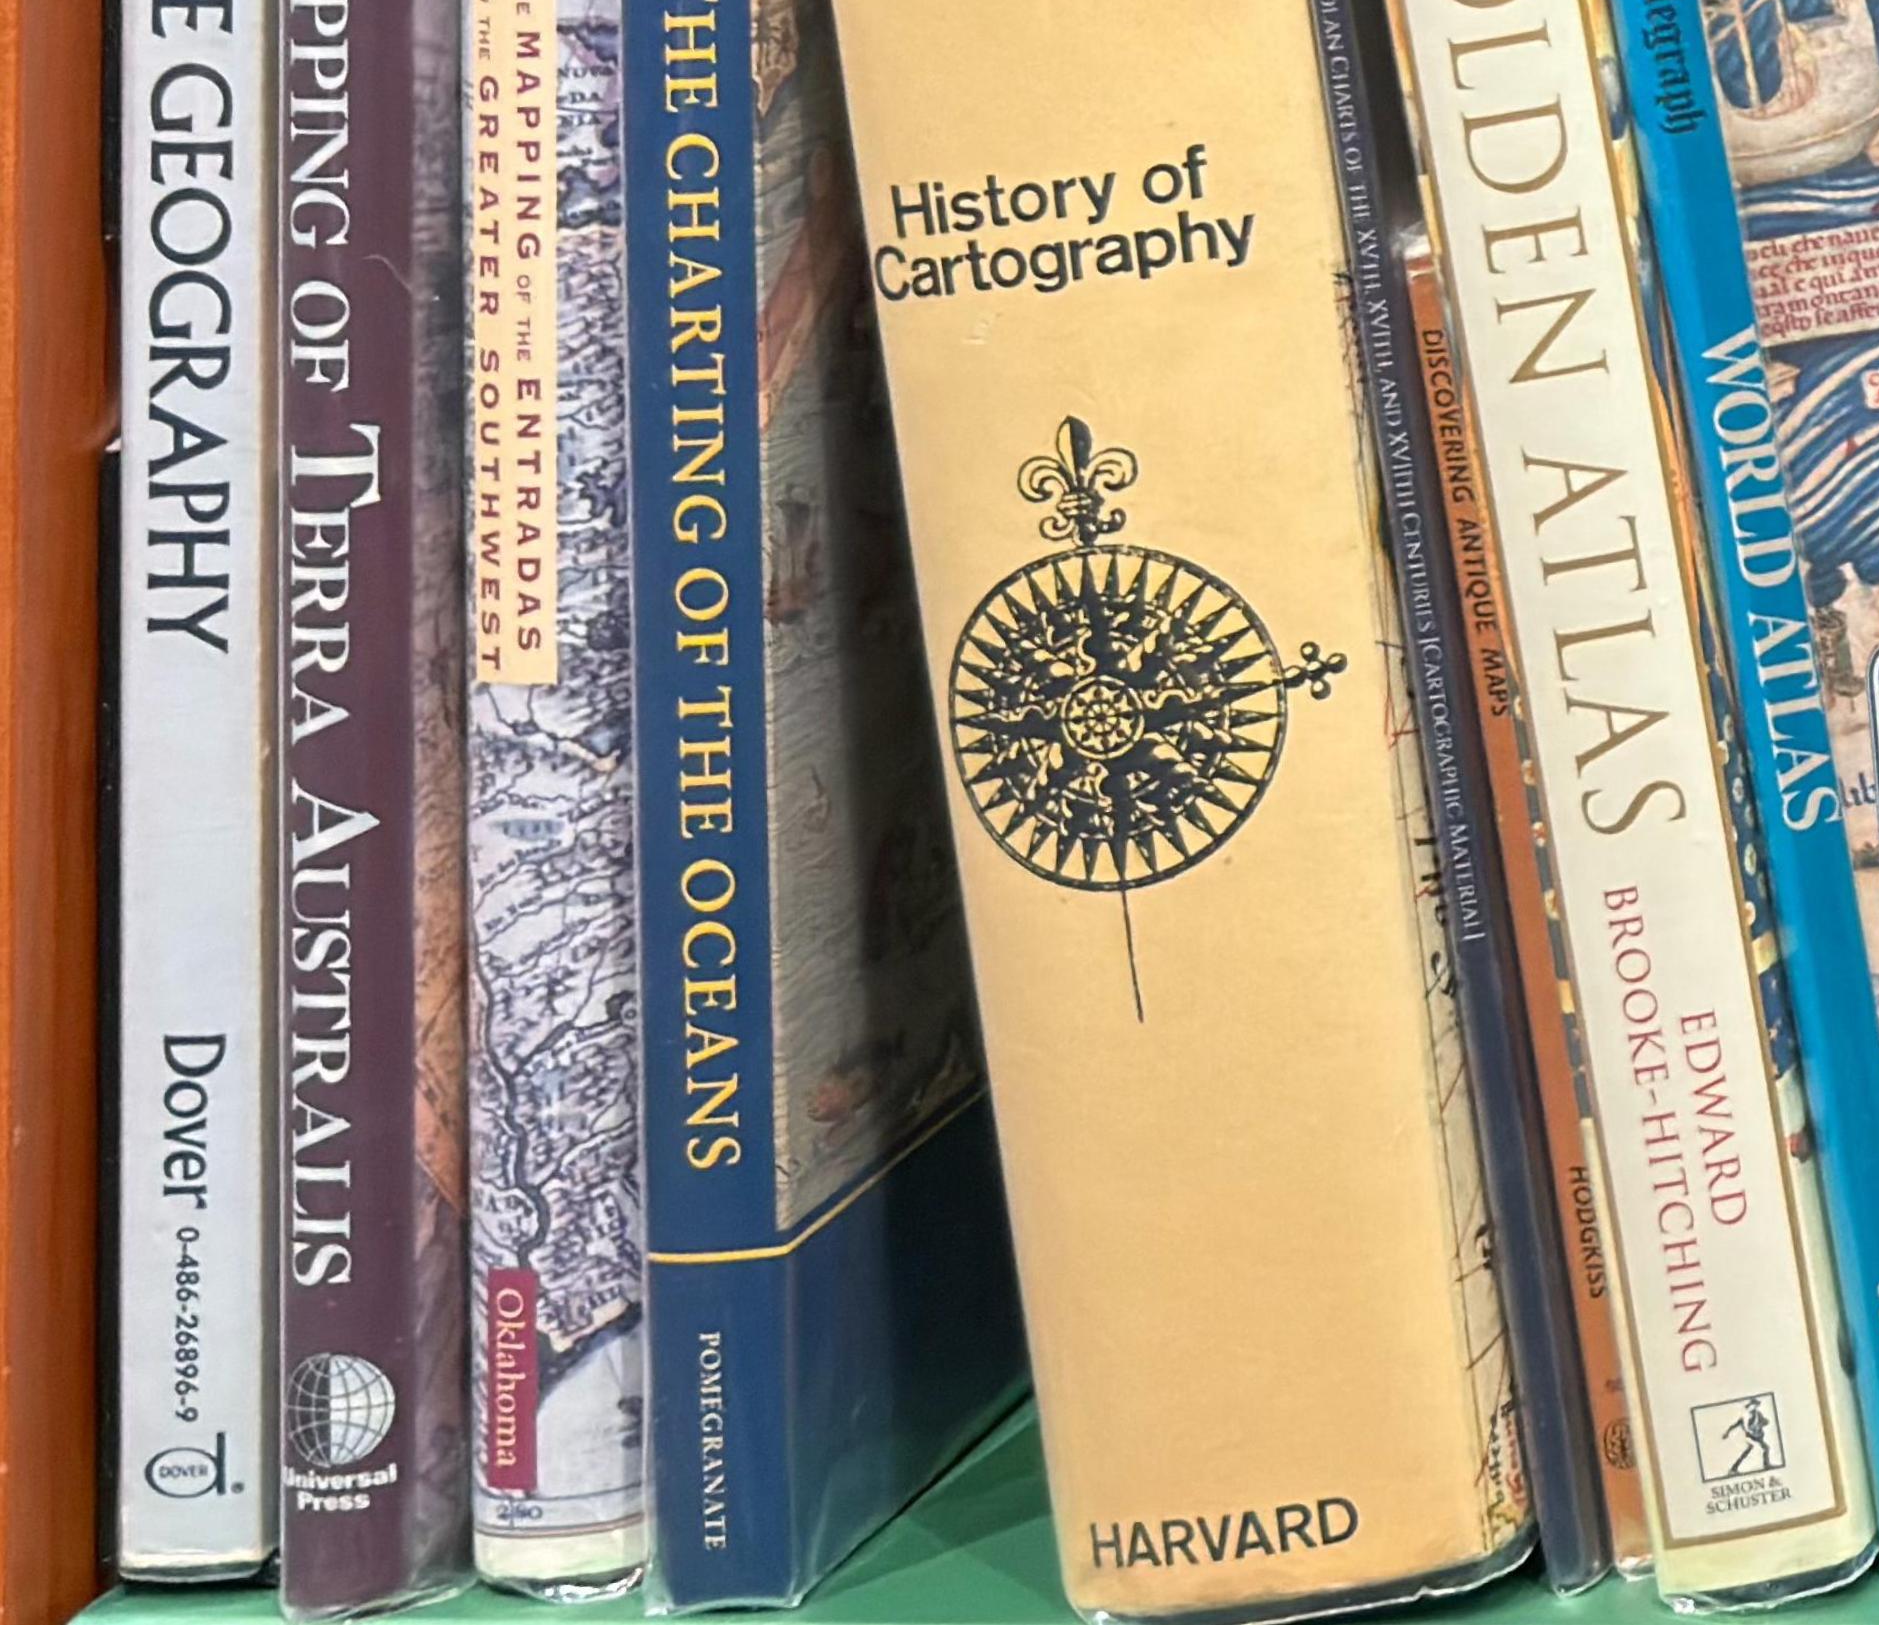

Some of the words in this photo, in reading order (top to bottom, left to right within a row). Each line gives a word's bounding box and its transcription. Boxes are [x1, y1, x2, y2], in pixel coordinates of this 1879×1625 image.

[478, 17, 491, 60] THE
[478, 76, 499, 314] GREATER
[517, 30, 540, 261] MAPPING
[891, 172, 1117, 238] History
[1141, 145, 1208, 199] of
[290, 281, 350, 392] OF
[518, 274, 532, 303] OF
[518, 317, 531, 361] THE
[665, 132, 727, 544] CHARTING
[872, 212, 1255, 308] Cartography
[147, 62, 233, 654] GEOGRAPHY
[291, 423, 381, 747] TERRA
[479, 350, 501, 672] SOUTHWEST
[517, 378, 541, 651] ENTRADAS
[1422, 331, 1474, 504] DISCOVERING
[1457, 518, 1497, 633] ANTIQUE
[1480, 649, 1511, 717] MAPS
[1702, 324, 1797, 587] WORLD
[1750, 612, 1840, 831] ATLAS
[675, 567, 730, 666] OF
[1523, 446, 1687, 837] ATLAS
[677, 686, 734, 839] THE
[290, 780, 381, 1287] AUSTRALIS
[680, 859, 740, 1169] OCEANS
[163, 1034, 225, 1209] Dover
[1603, 887, 1717, 1374] BROOKE-HITCHING
[1680, 1009, 1747, 1228] EDWARD
[174, 1227, 200, 1422] 0-486-26896-9
[496, 1287, 524, 1467] Oklahoma
[158, 1464, 209, 1480] DOVER
[298, 1491, 370, 1511] Press
[699, 1331, 726, 1550] POMEGRANATE
[1088, 1494, 1362, 1572] HARVARD
[1706, 1487, 1791, 1515] SCHUSTER
[1711, 1478, 1764, 1500] SIMON
